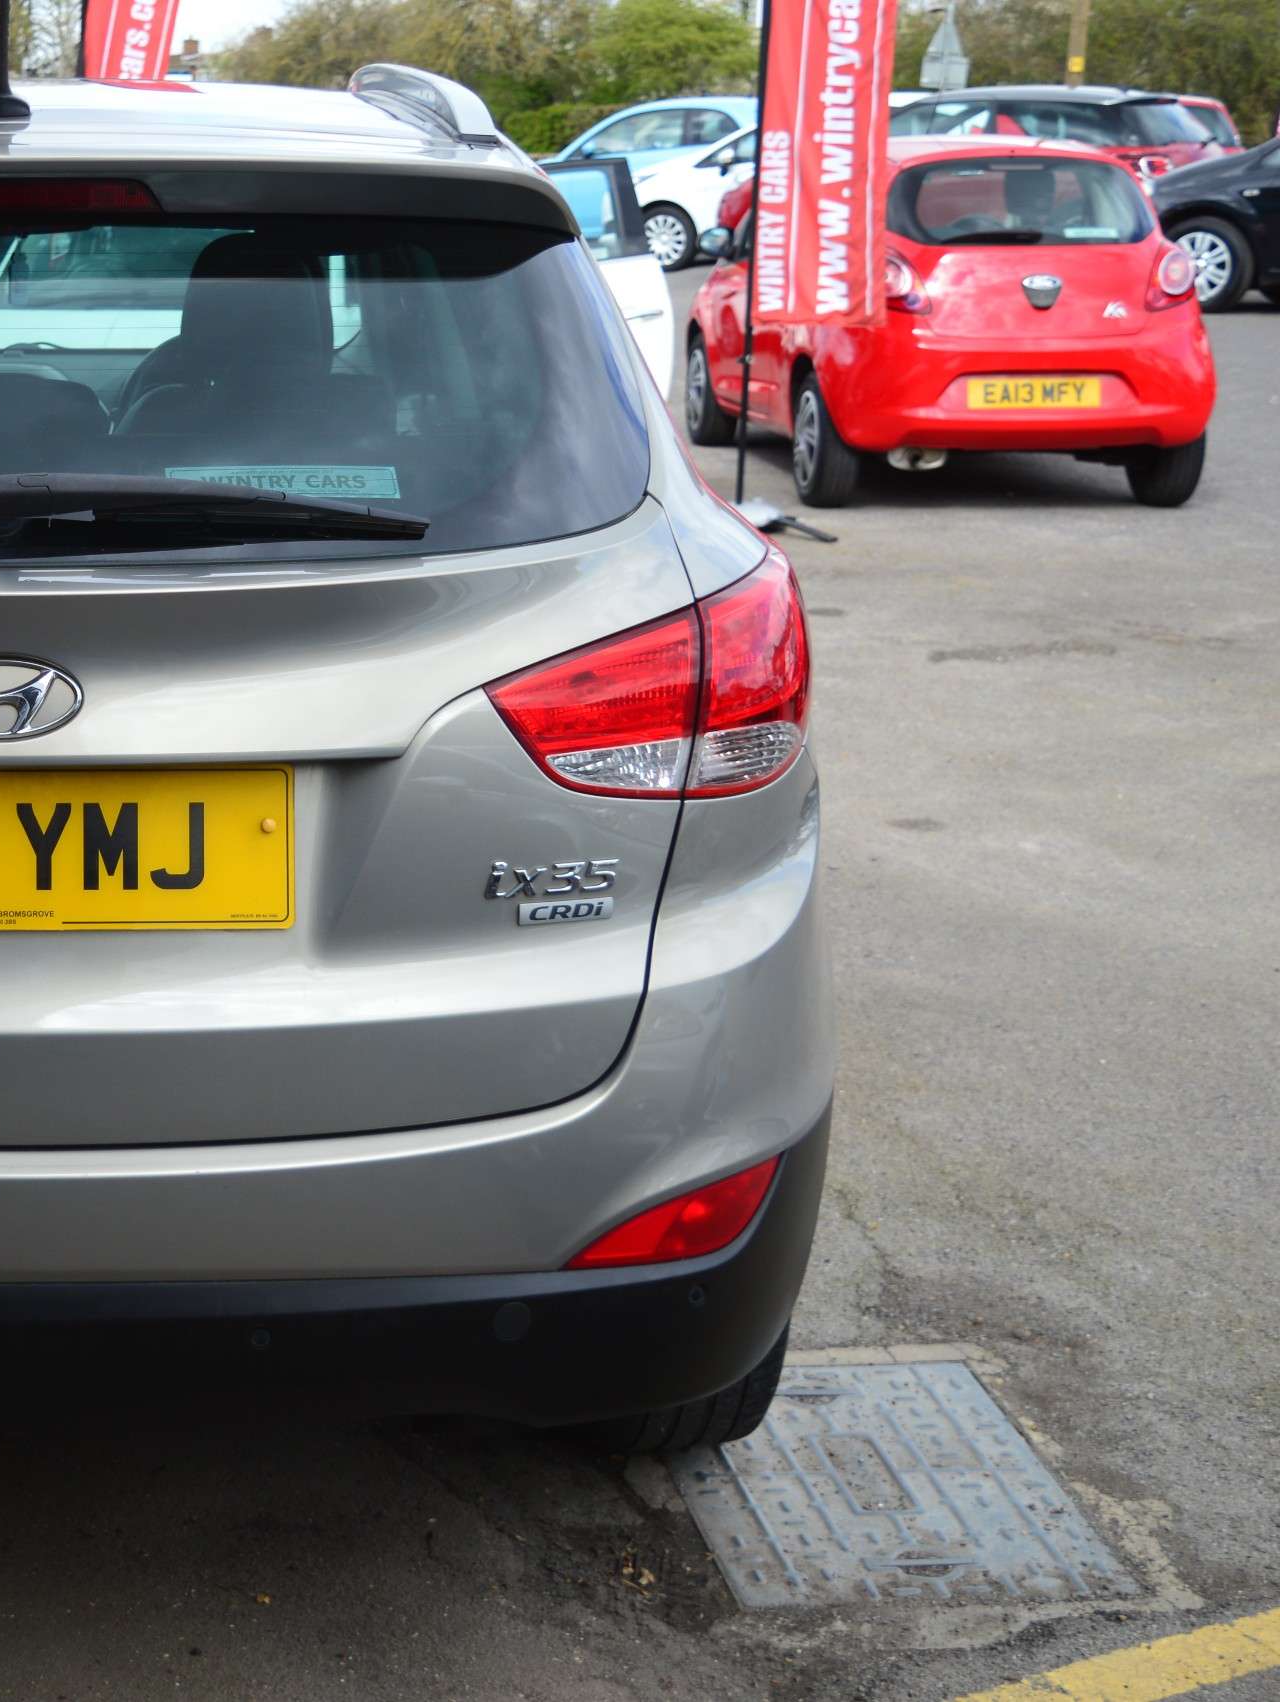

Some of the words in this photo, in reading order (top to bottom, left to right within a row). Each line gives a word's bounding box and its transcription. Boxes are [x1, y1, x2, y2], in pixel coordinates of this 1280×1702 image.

[758, 130, 791, 205] CARS
[757, 210, 787, 313] WINTRY
[983, 383, 1035, 403] EA13
[1041, 382, 1086, 402] MFY
[305, 474, 366, 489] CARS
[16, 802, 205, 891] YMJ
[529, 901, 604, 921] CRDi
